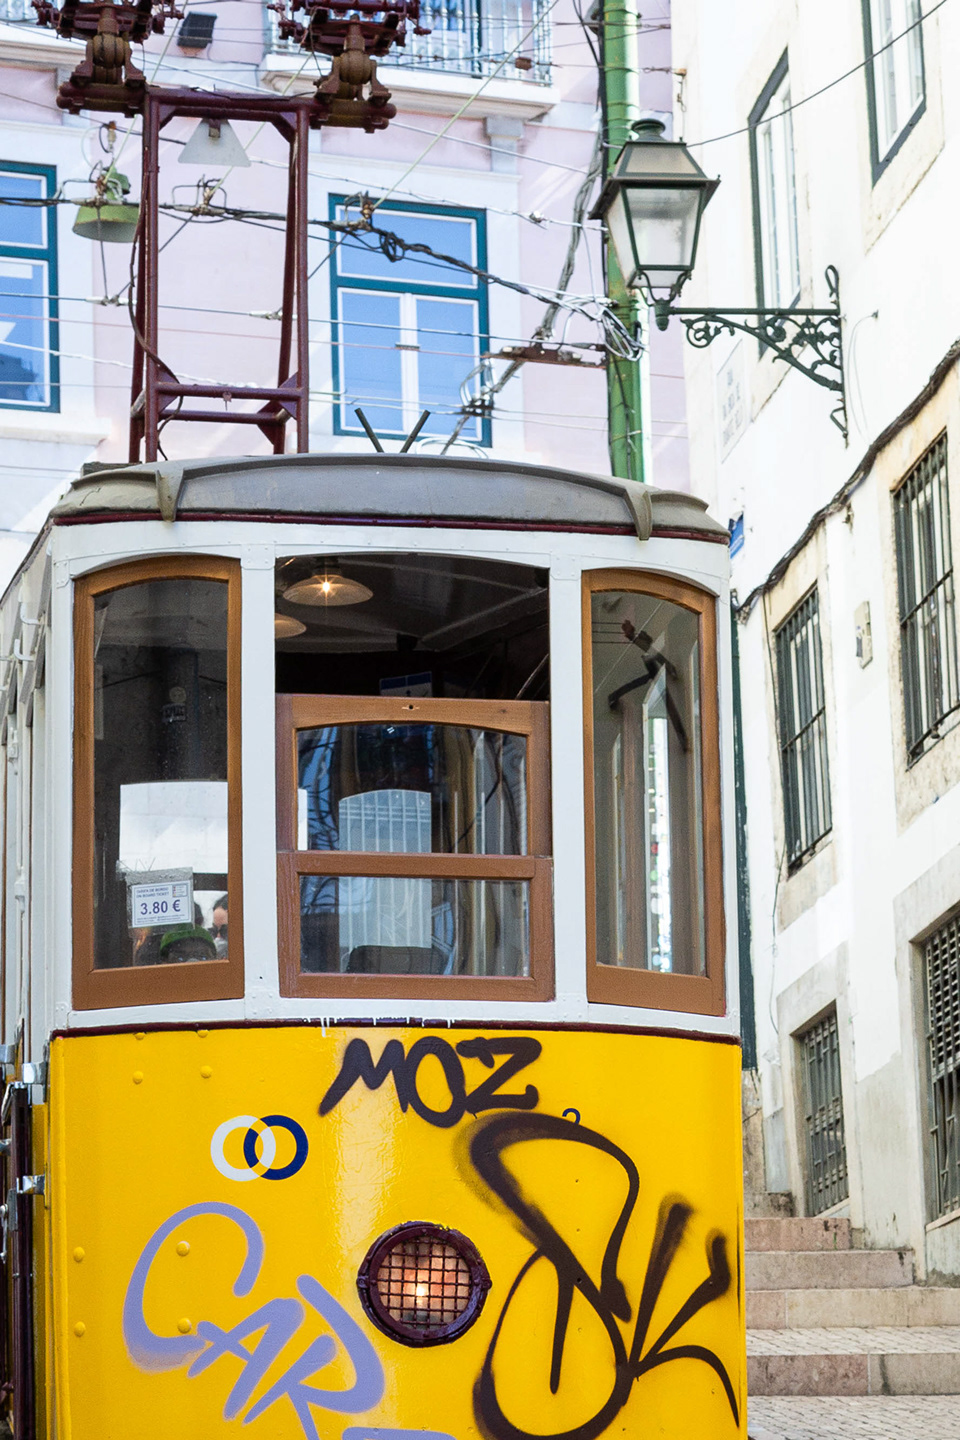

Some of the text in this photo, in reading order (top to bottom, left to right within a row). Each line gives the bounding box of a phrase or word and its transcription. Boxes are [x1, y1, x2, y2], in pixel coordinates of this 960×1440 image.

[140, 899, 181, 915] 3.80 €
[319, 1036, 543, 1128] MOZ
